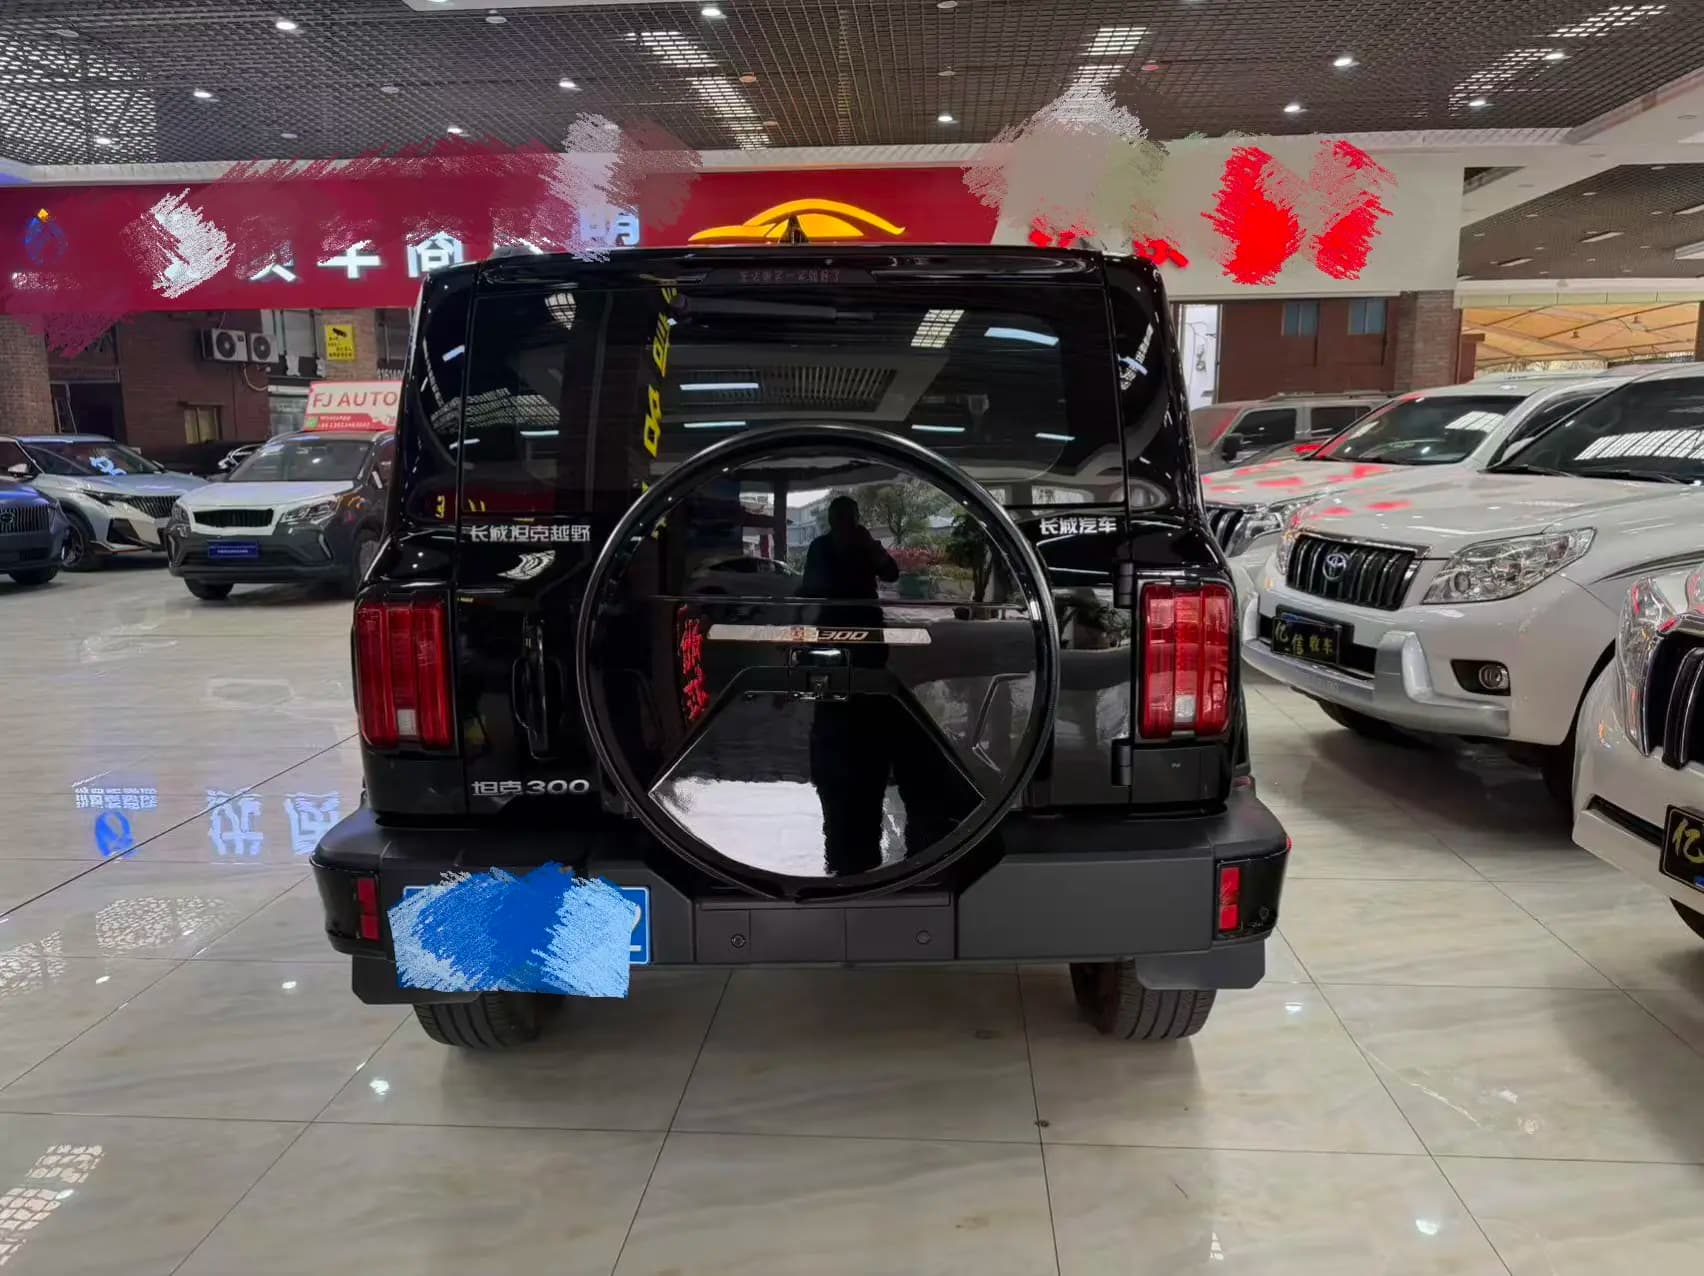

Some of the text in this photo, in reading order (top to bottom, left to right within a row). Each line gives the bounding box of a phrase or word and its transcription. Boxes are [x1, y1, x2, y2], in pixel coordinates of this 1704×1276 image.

[337, 391, 398, 407] AUTO
[469, 525, 591, 542] 长城坦克越野
[1039, 517, 1117, 535] 长城汽车
